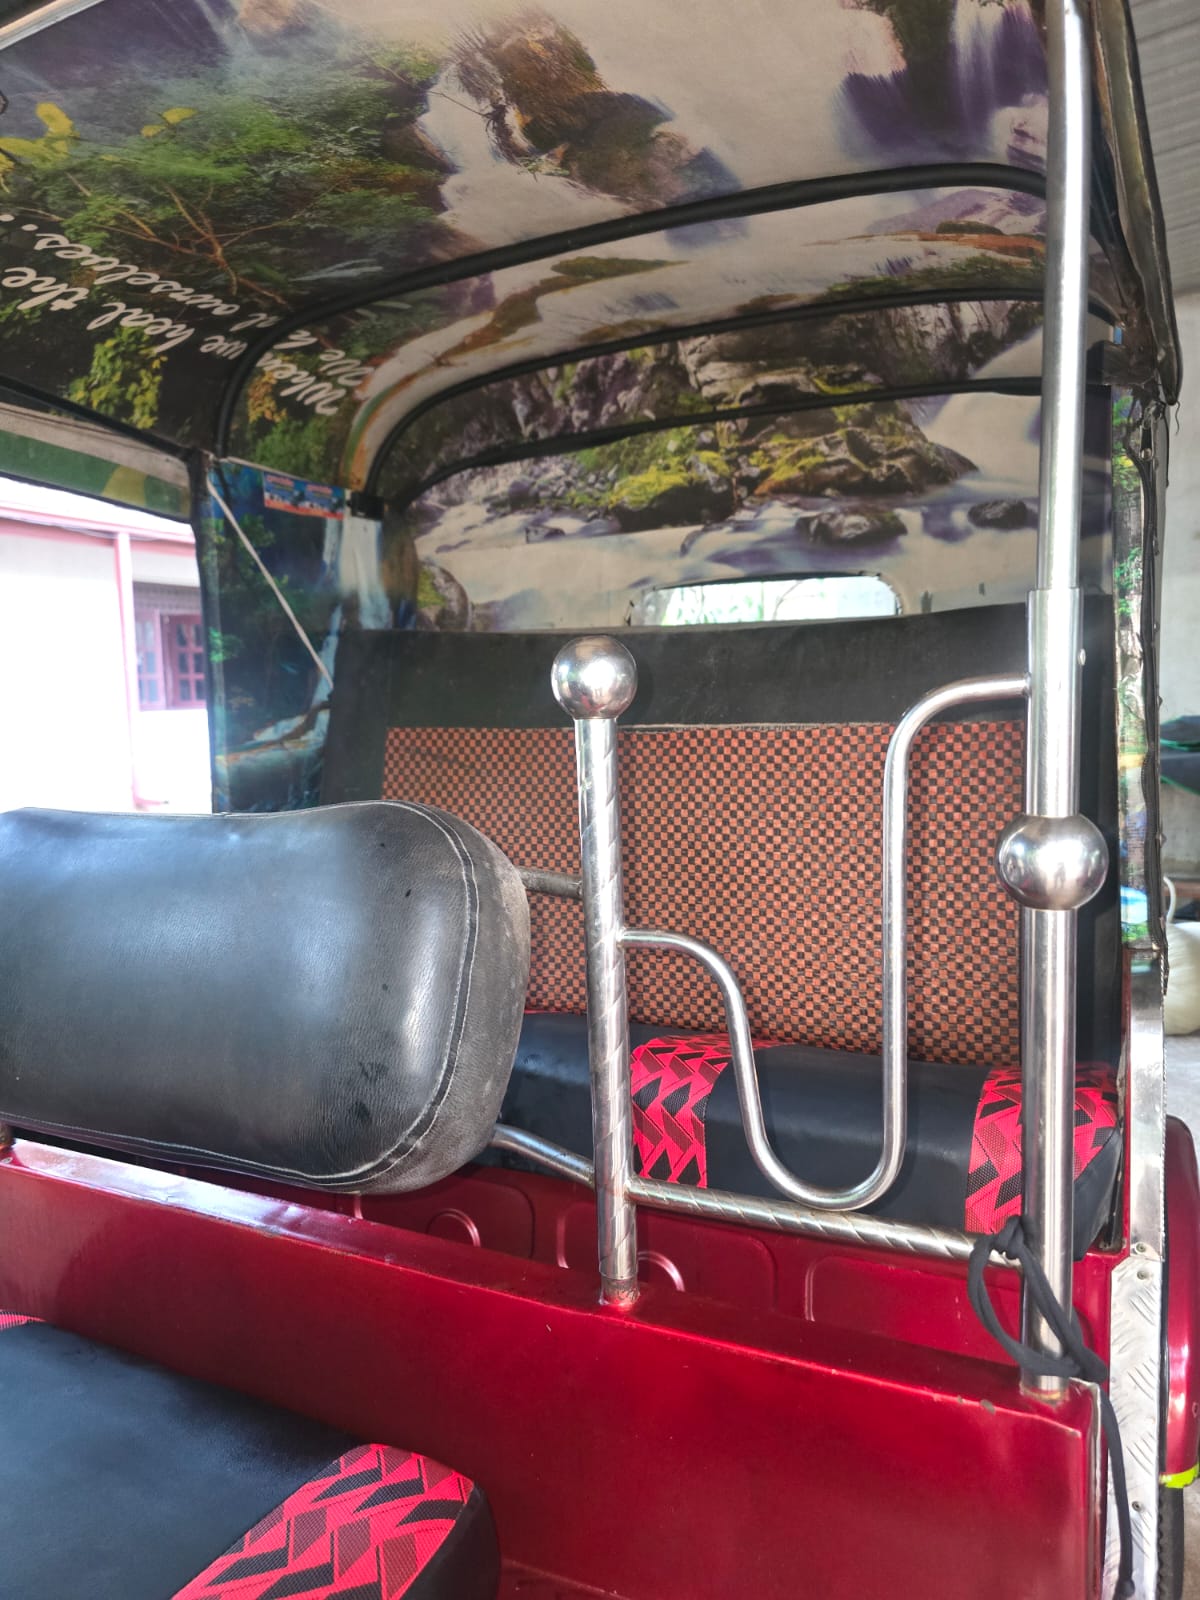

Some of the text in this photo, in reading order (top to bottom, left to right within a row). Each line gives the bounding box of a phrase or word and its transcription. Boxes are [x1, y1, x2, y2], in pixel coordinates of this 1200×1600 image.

[1, 266, 346, 416] When we heal the
[319, 349, 375, 387] We
